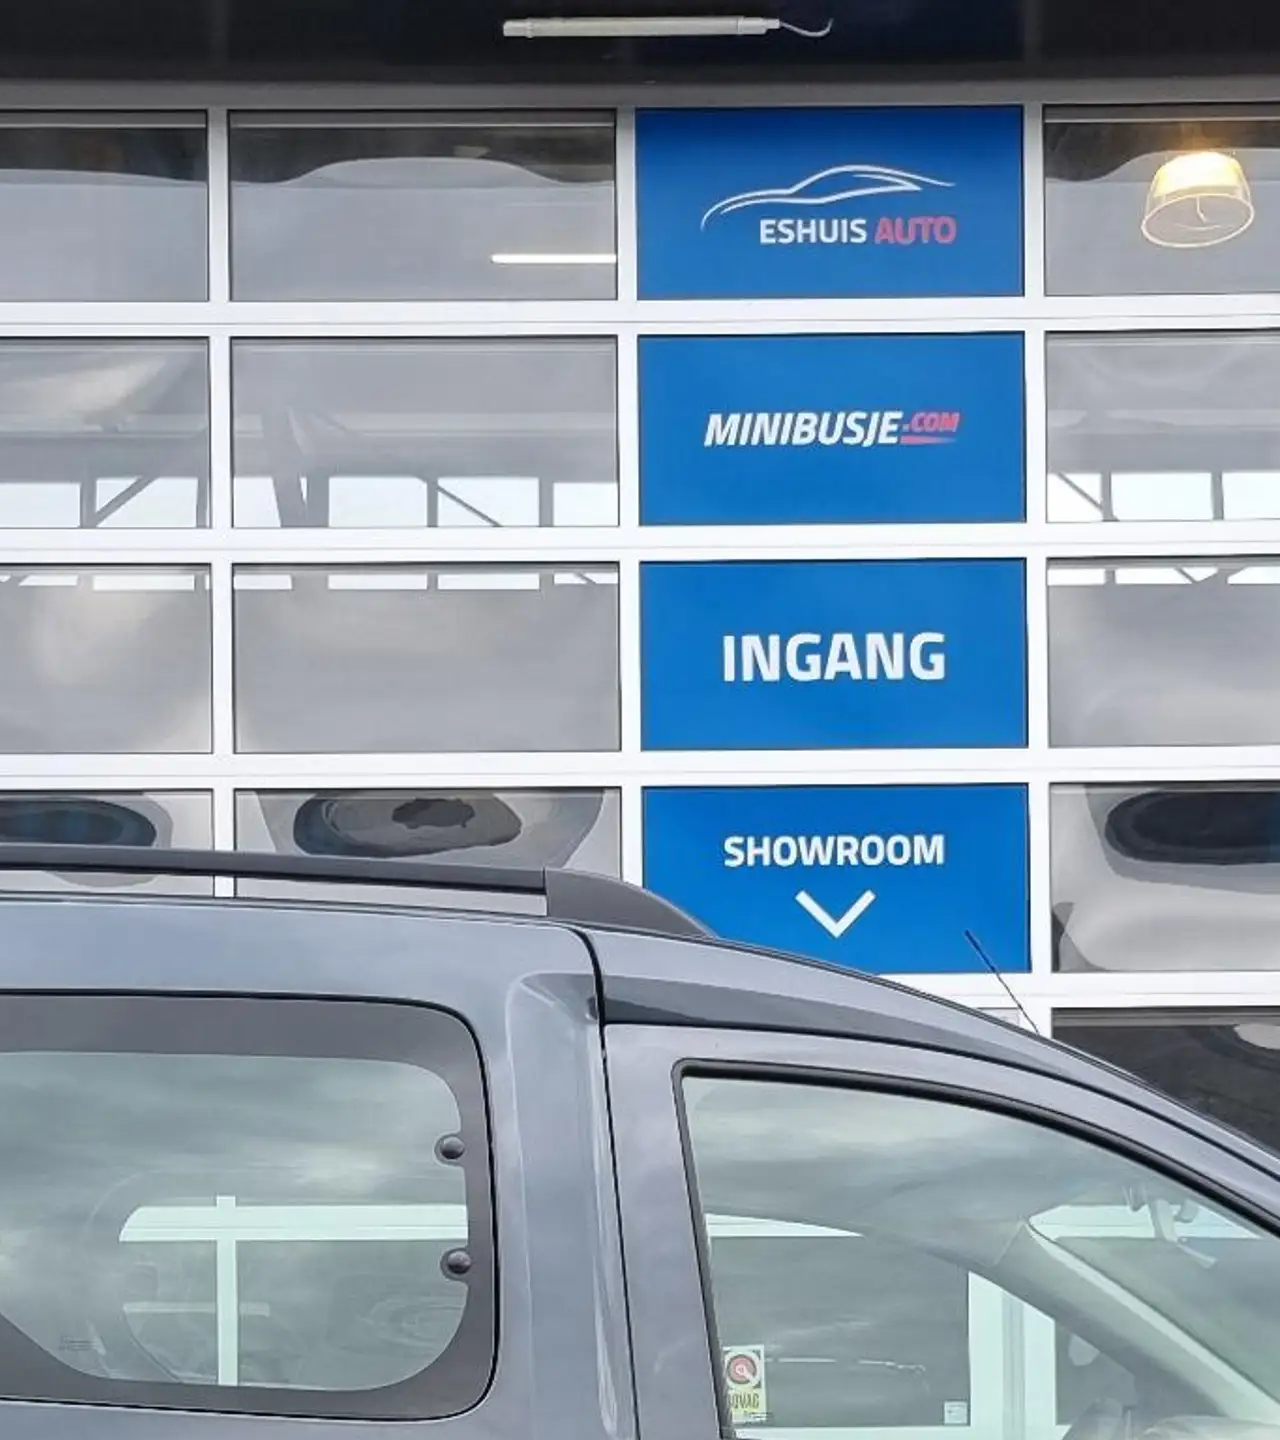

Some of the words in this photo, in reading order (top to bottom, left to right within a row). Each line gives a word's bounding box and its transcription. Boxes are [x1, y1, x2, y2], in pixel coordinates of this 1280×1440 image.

[760, 218, 867, 244] ESHUIS
[875, 216, 957, 244] AUTO
[723, 632, 946, 682] INGANG
[723, 834, 945, 867] SHOWROOM
